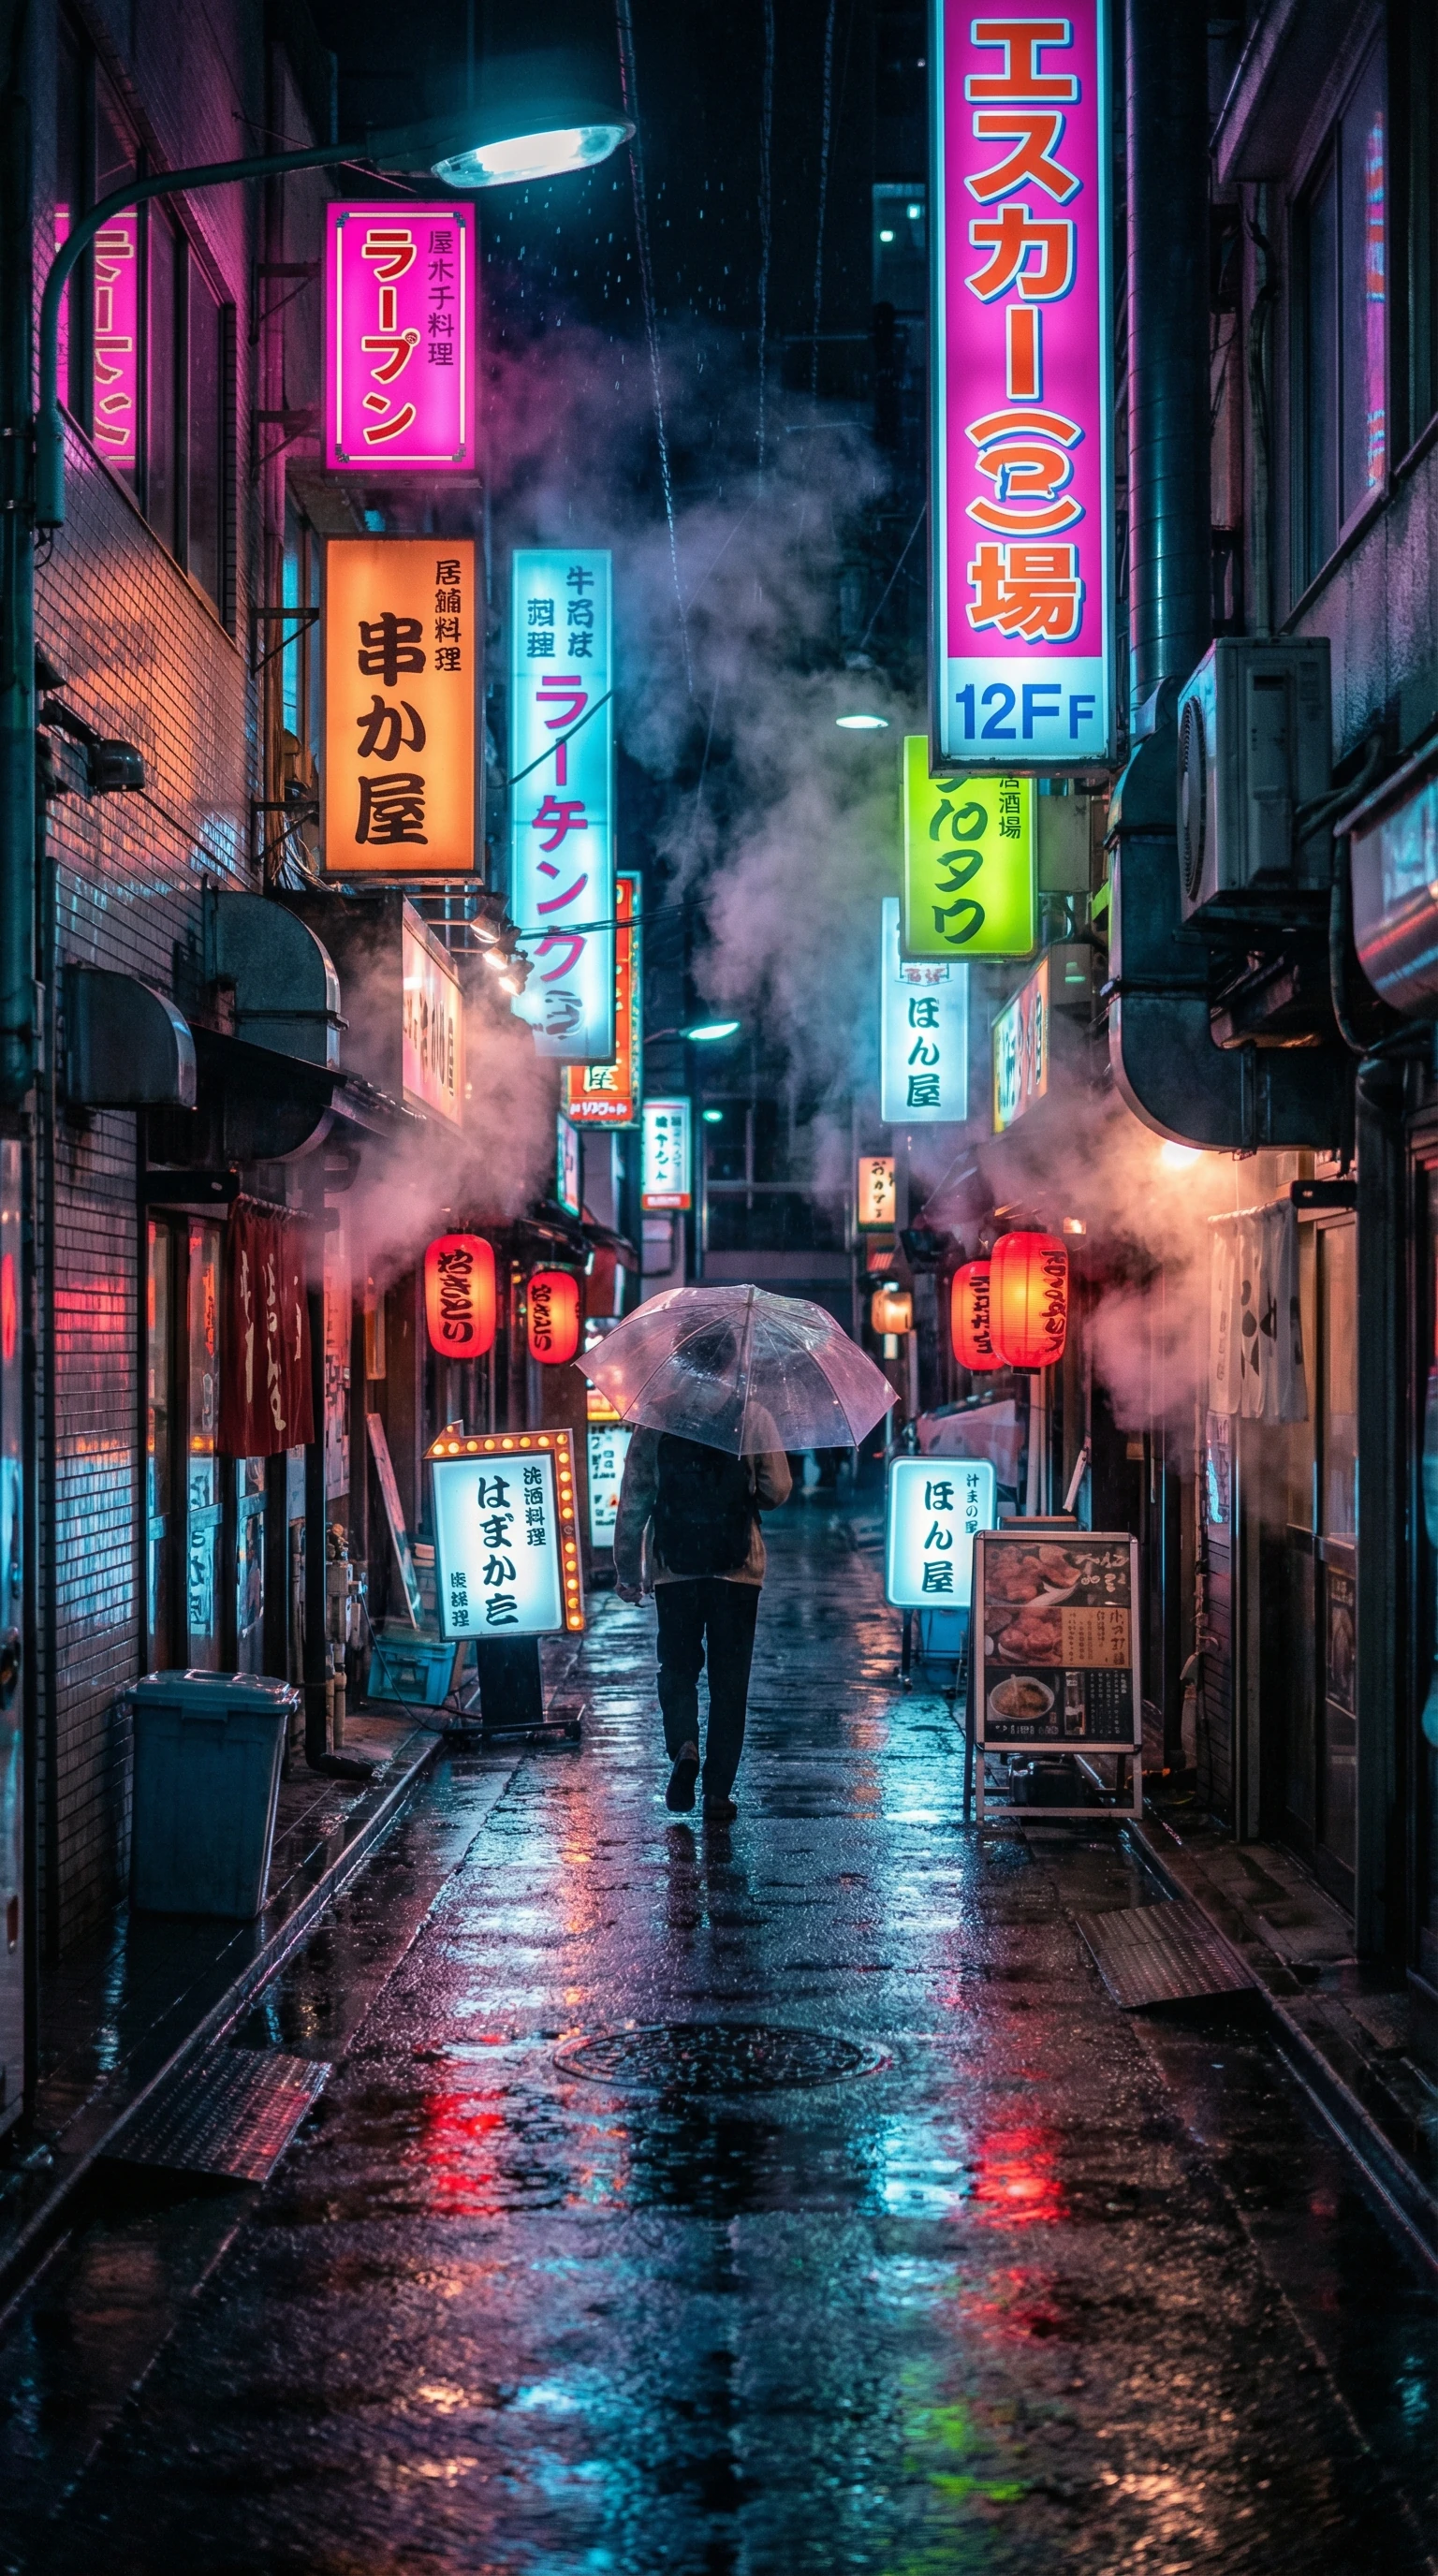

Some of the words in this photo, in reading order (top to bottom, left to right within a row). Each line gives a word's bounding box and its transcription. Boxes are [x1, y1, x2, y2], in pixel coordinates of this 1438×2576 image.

[360, 228, 421, 446] ラープン
[355, 611, 429, 845] 串か屋
[906, 997, 942, 1107] ほん屋
[921, 1481, 955, 1593] ほん屋
